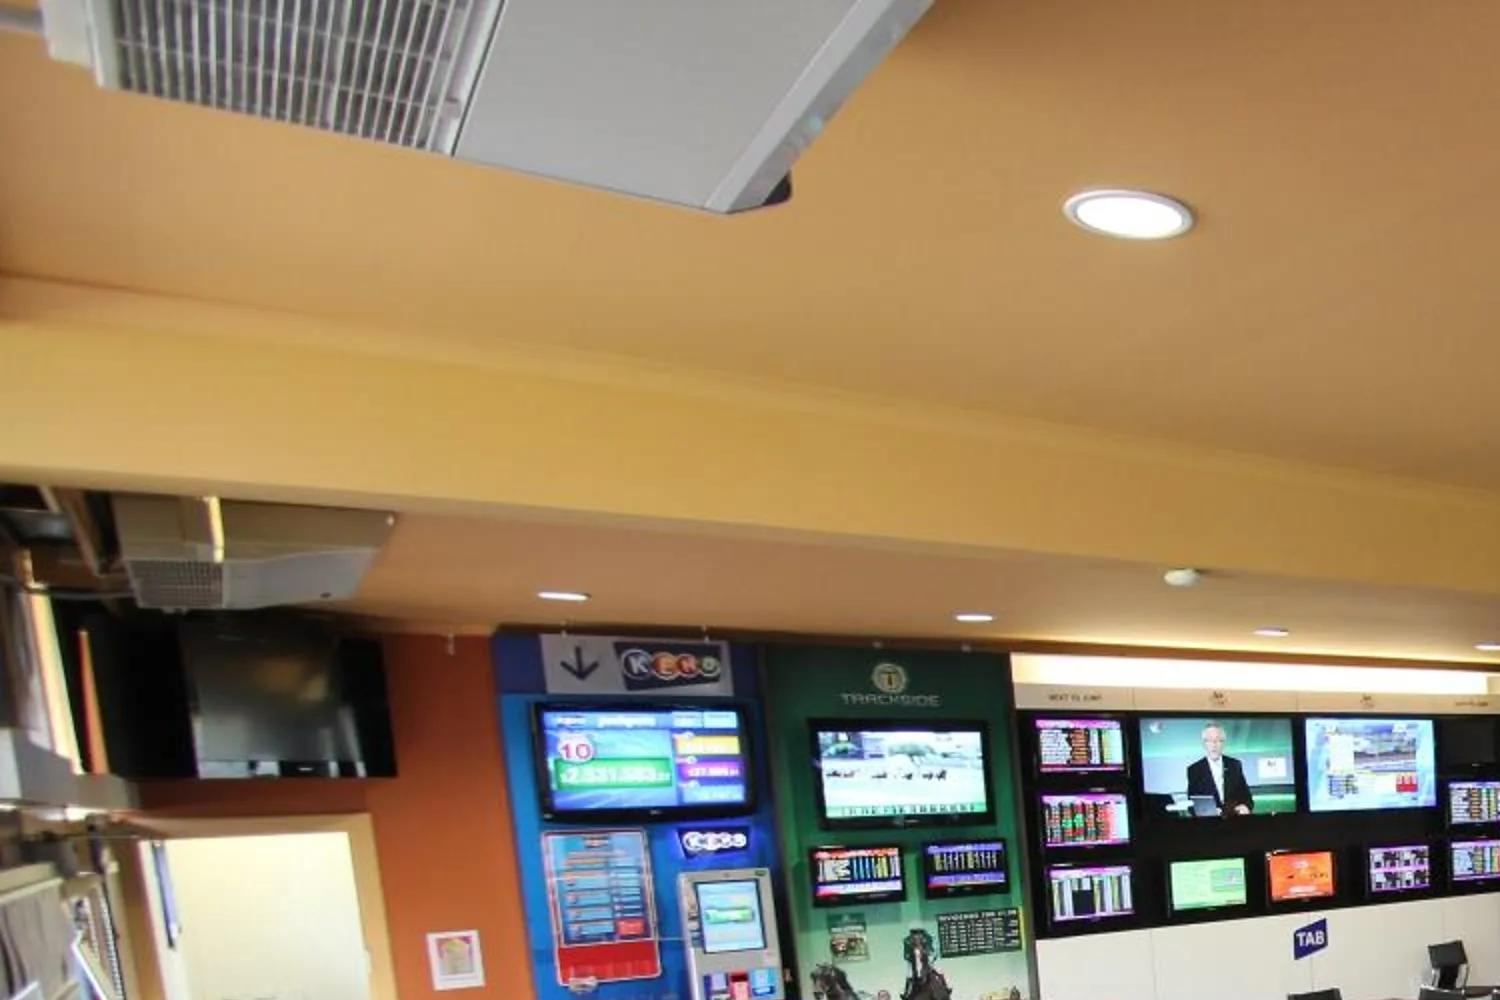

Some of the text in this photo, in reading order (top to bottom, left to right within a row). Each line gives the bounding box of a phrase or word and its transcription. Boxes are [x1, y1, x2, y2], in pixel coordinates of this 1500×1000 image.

[622, 650, 720, 679] KENO
[841, 693, 941, 706] TRACKSIDE
[560, 743, 591, 759] 10
[1296, 930, 1325, 947] TAB
